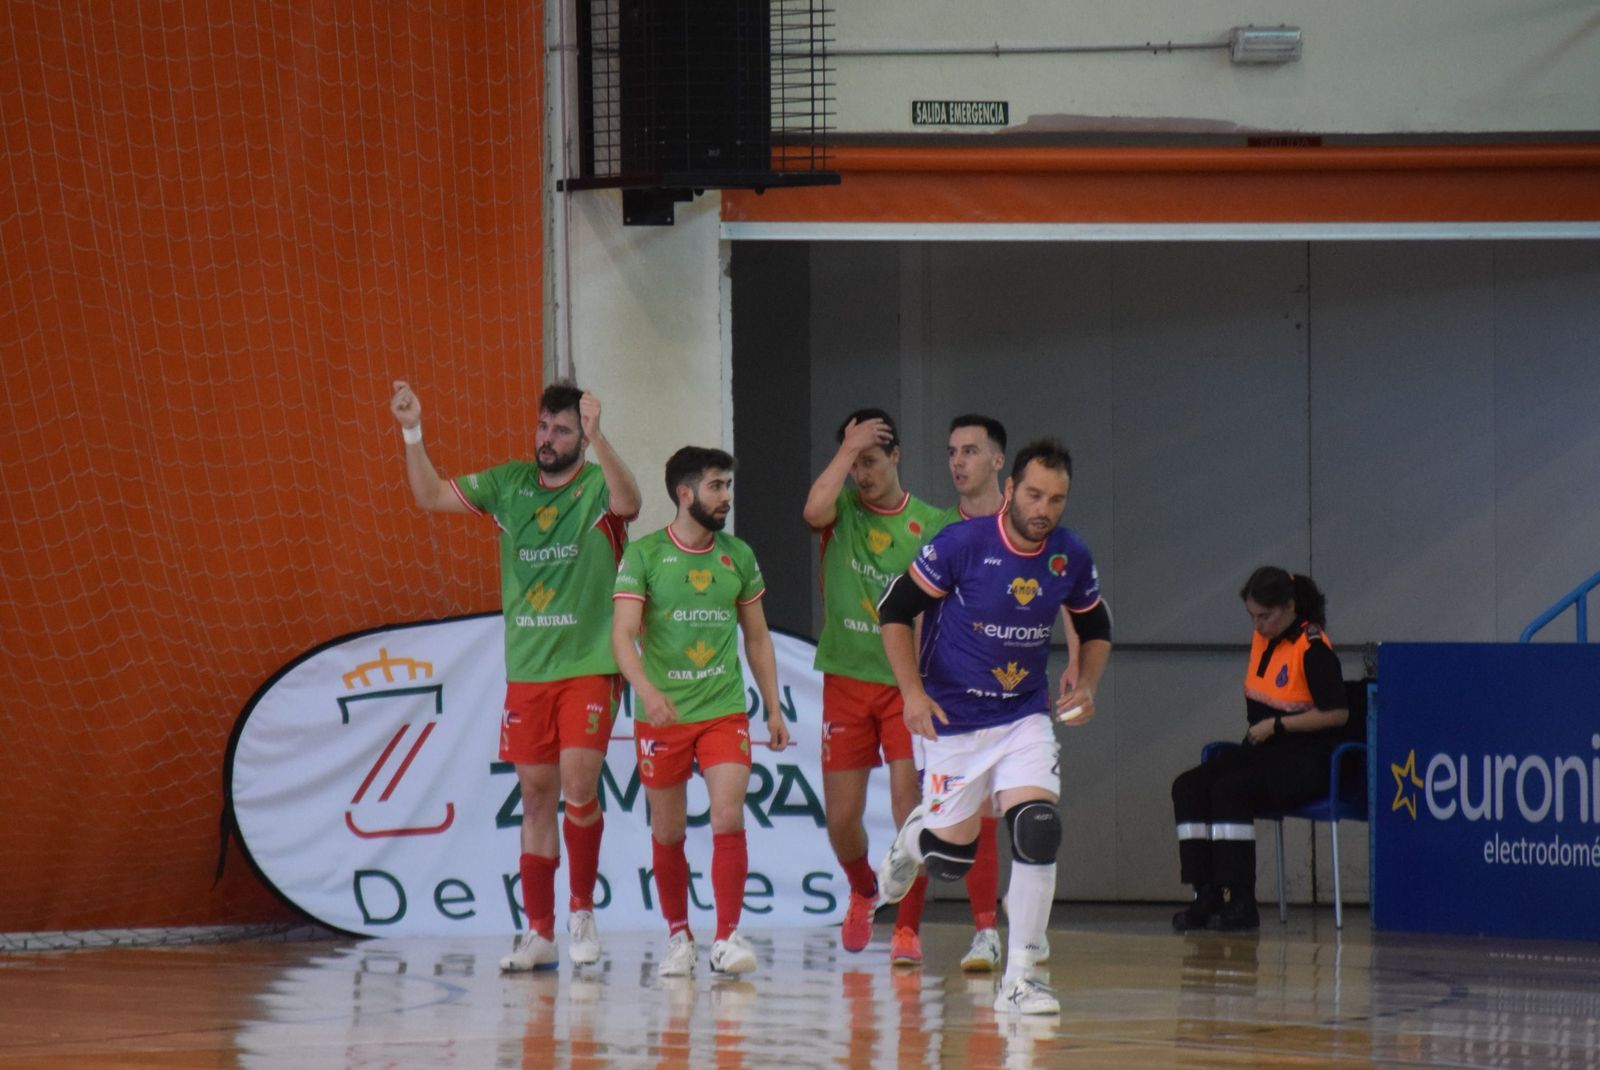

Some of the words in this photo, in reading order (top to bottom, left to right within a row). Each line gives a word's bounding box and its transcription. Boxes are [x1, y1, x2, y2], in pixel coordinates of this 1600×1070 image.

[916, 102, 947, 123] SALIDA
[949, 102, 1004, 124] EMERGENCIA
[519, 542, 578, 562] euronics
